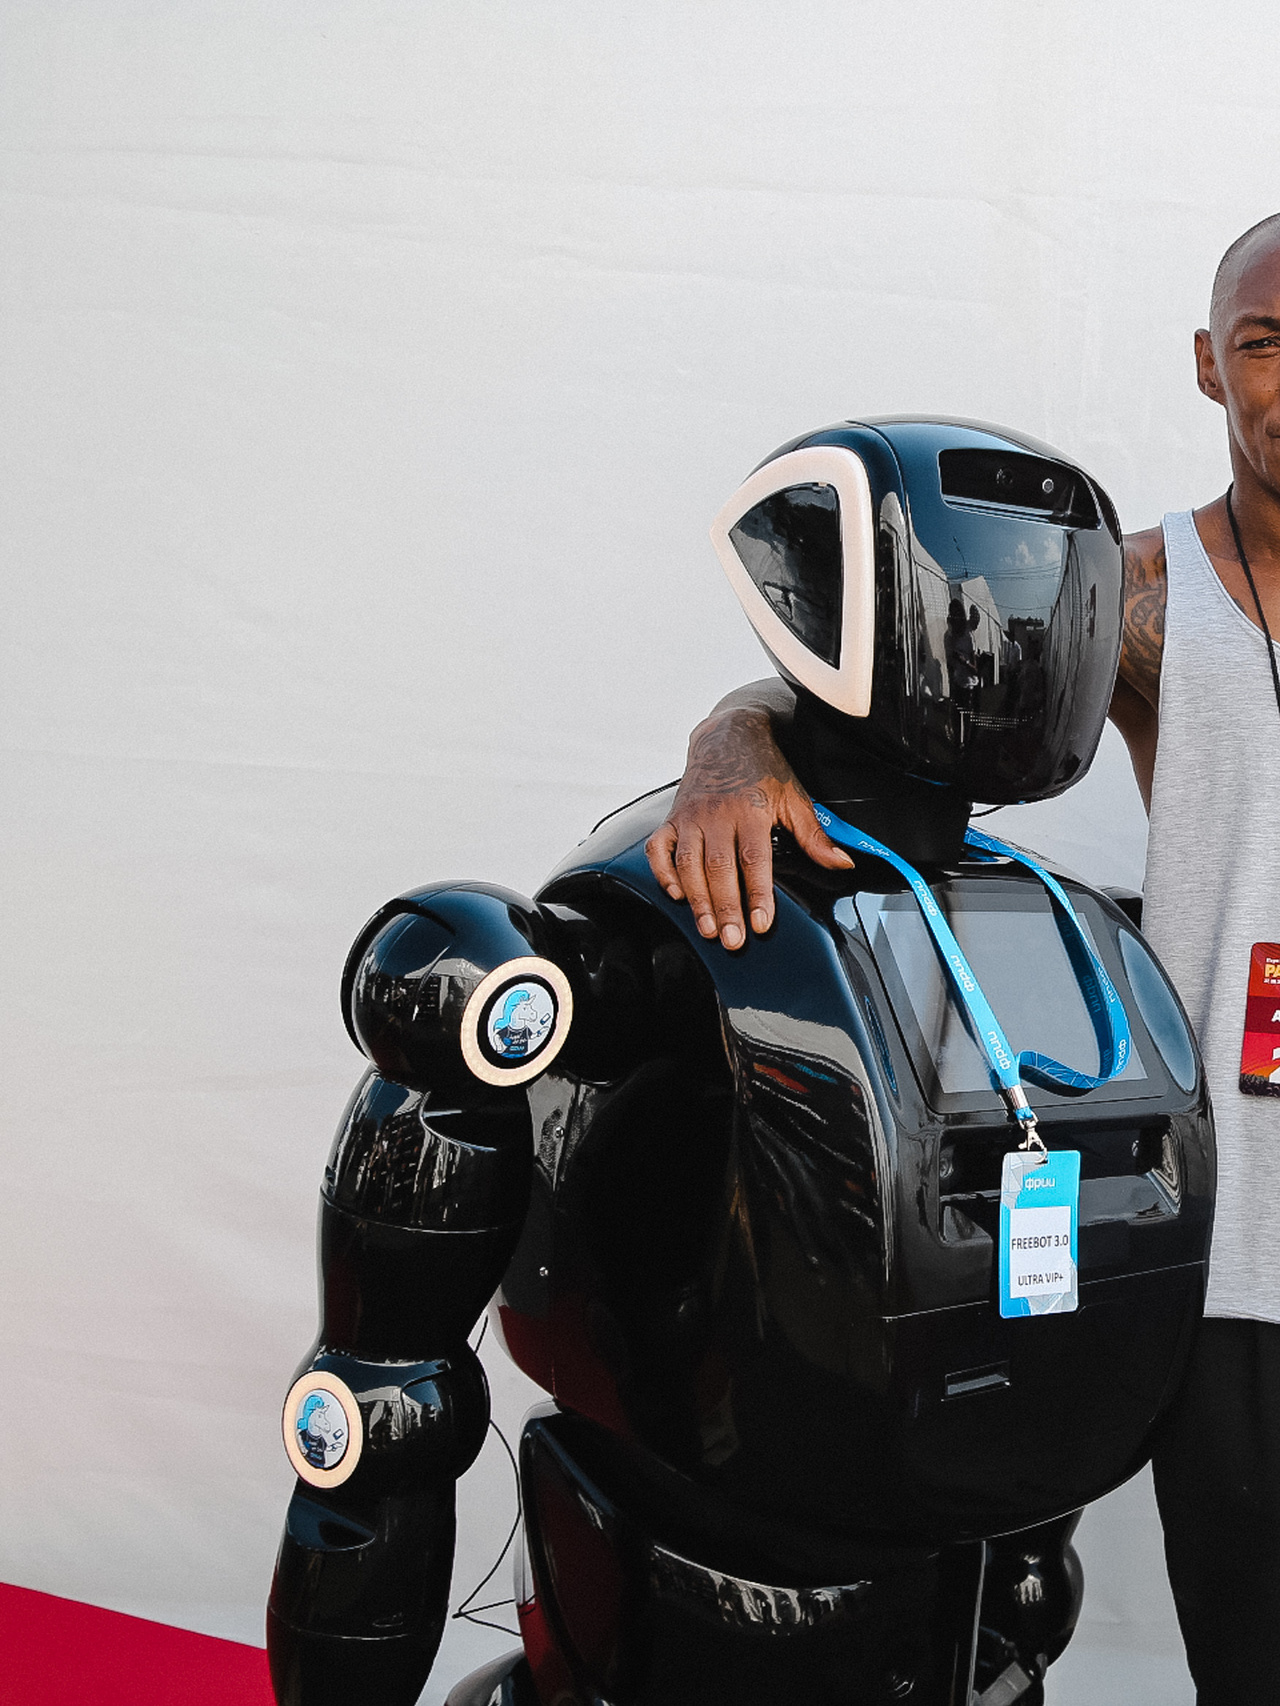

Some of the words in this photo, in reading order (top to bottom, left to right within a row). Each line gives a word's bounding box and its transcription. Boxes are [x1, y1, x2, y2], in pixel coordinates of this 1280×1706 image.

[1025, 1178, 1055, 1190] фрии
[1011, 1235, 1052, 1250] FREEBOT
[1054, 1234, 1069, 1247] 3.0
[1017, 1273, 1043, 1286] ULTRA
[1045, 1272, 1064, 1284] VIP+
